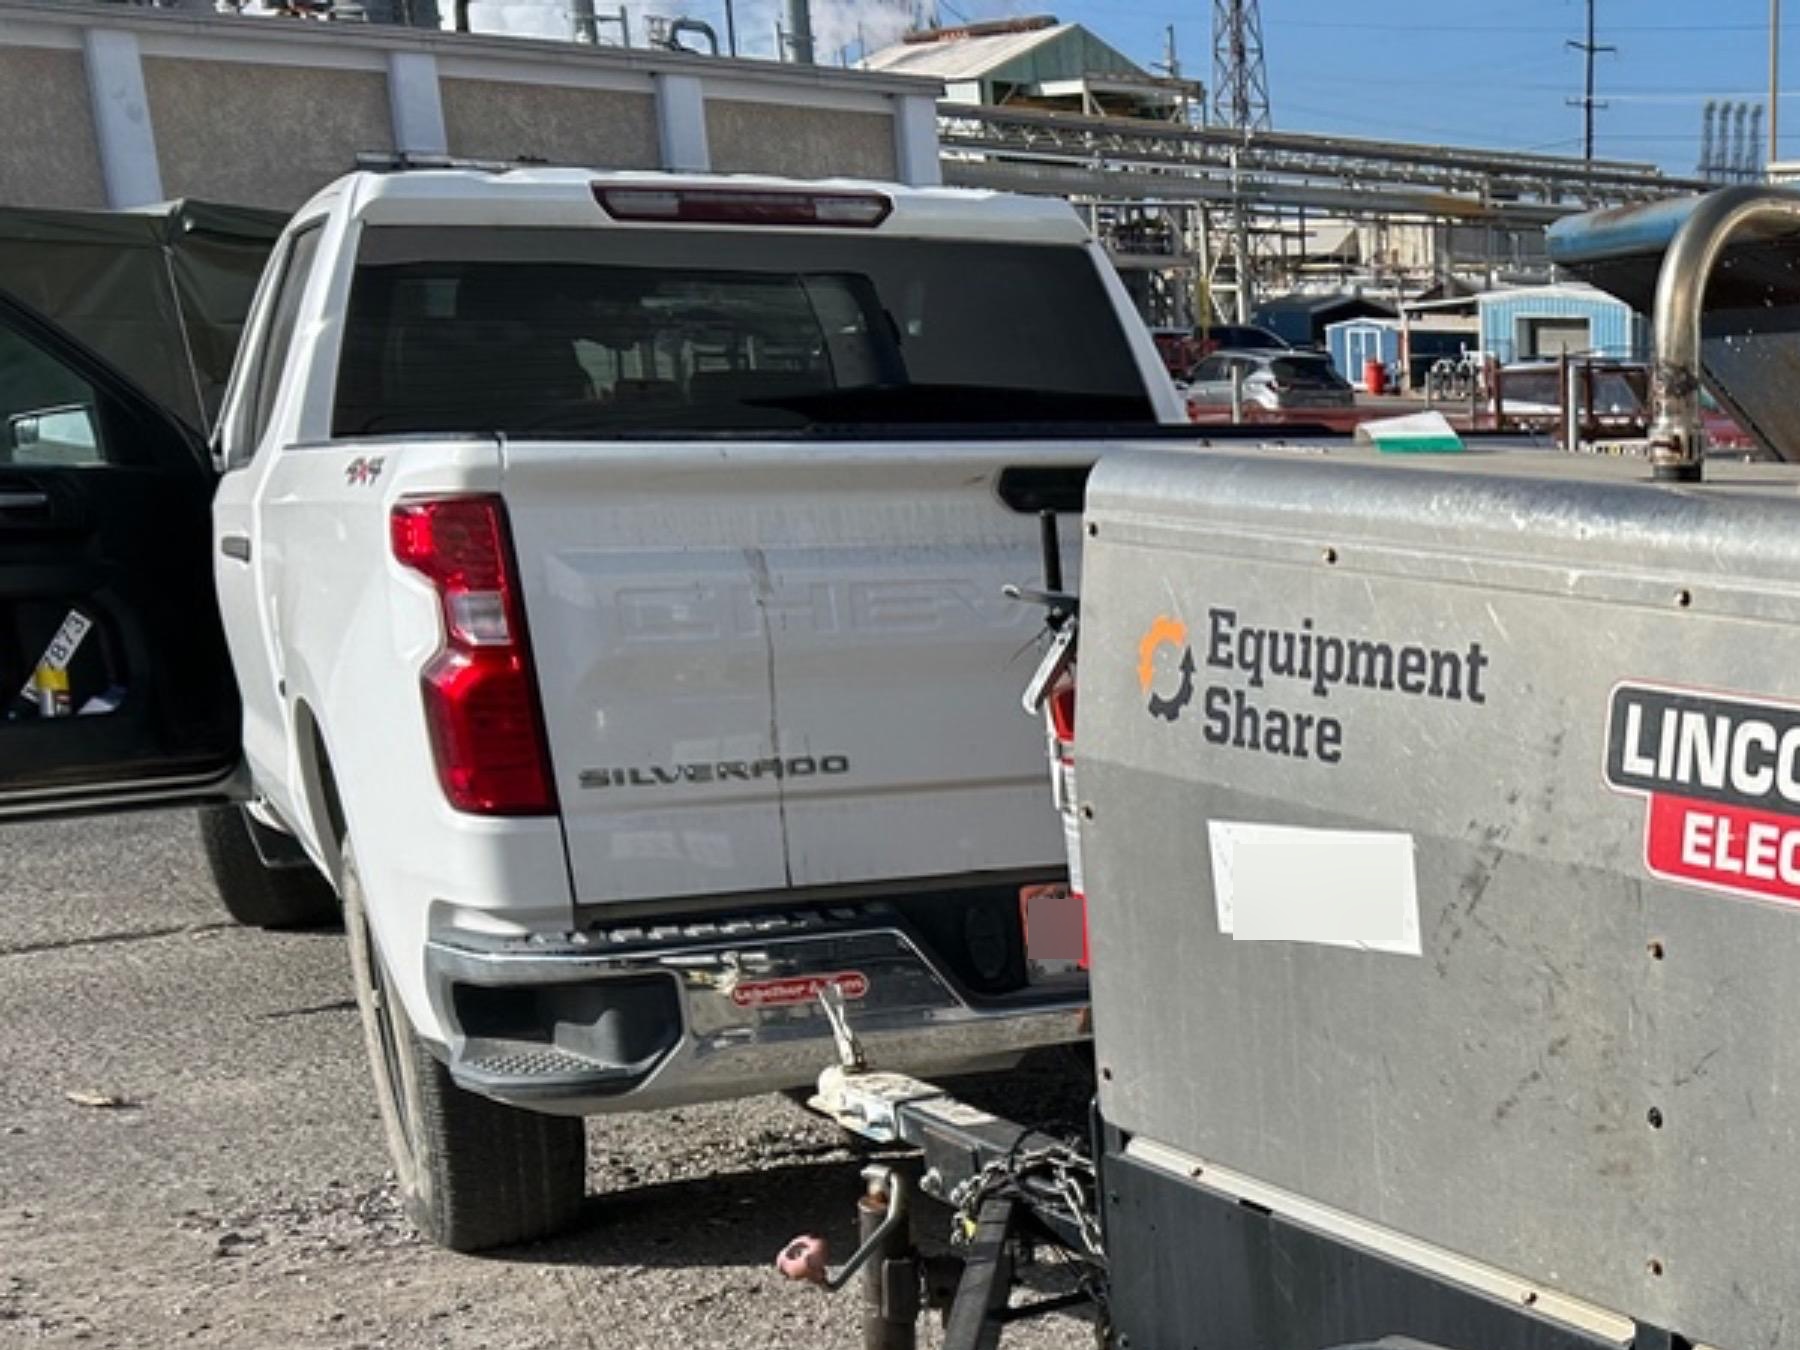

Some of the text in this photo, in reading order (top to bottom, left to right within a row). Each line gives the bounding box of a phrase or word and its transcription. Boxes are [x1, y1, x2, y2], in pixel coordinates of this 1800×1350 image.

[1206, 607, 1488, 704] Equipment
[1203, 686, 1342, 763] Share
[579, 755, 848, 788] SILVERADO
